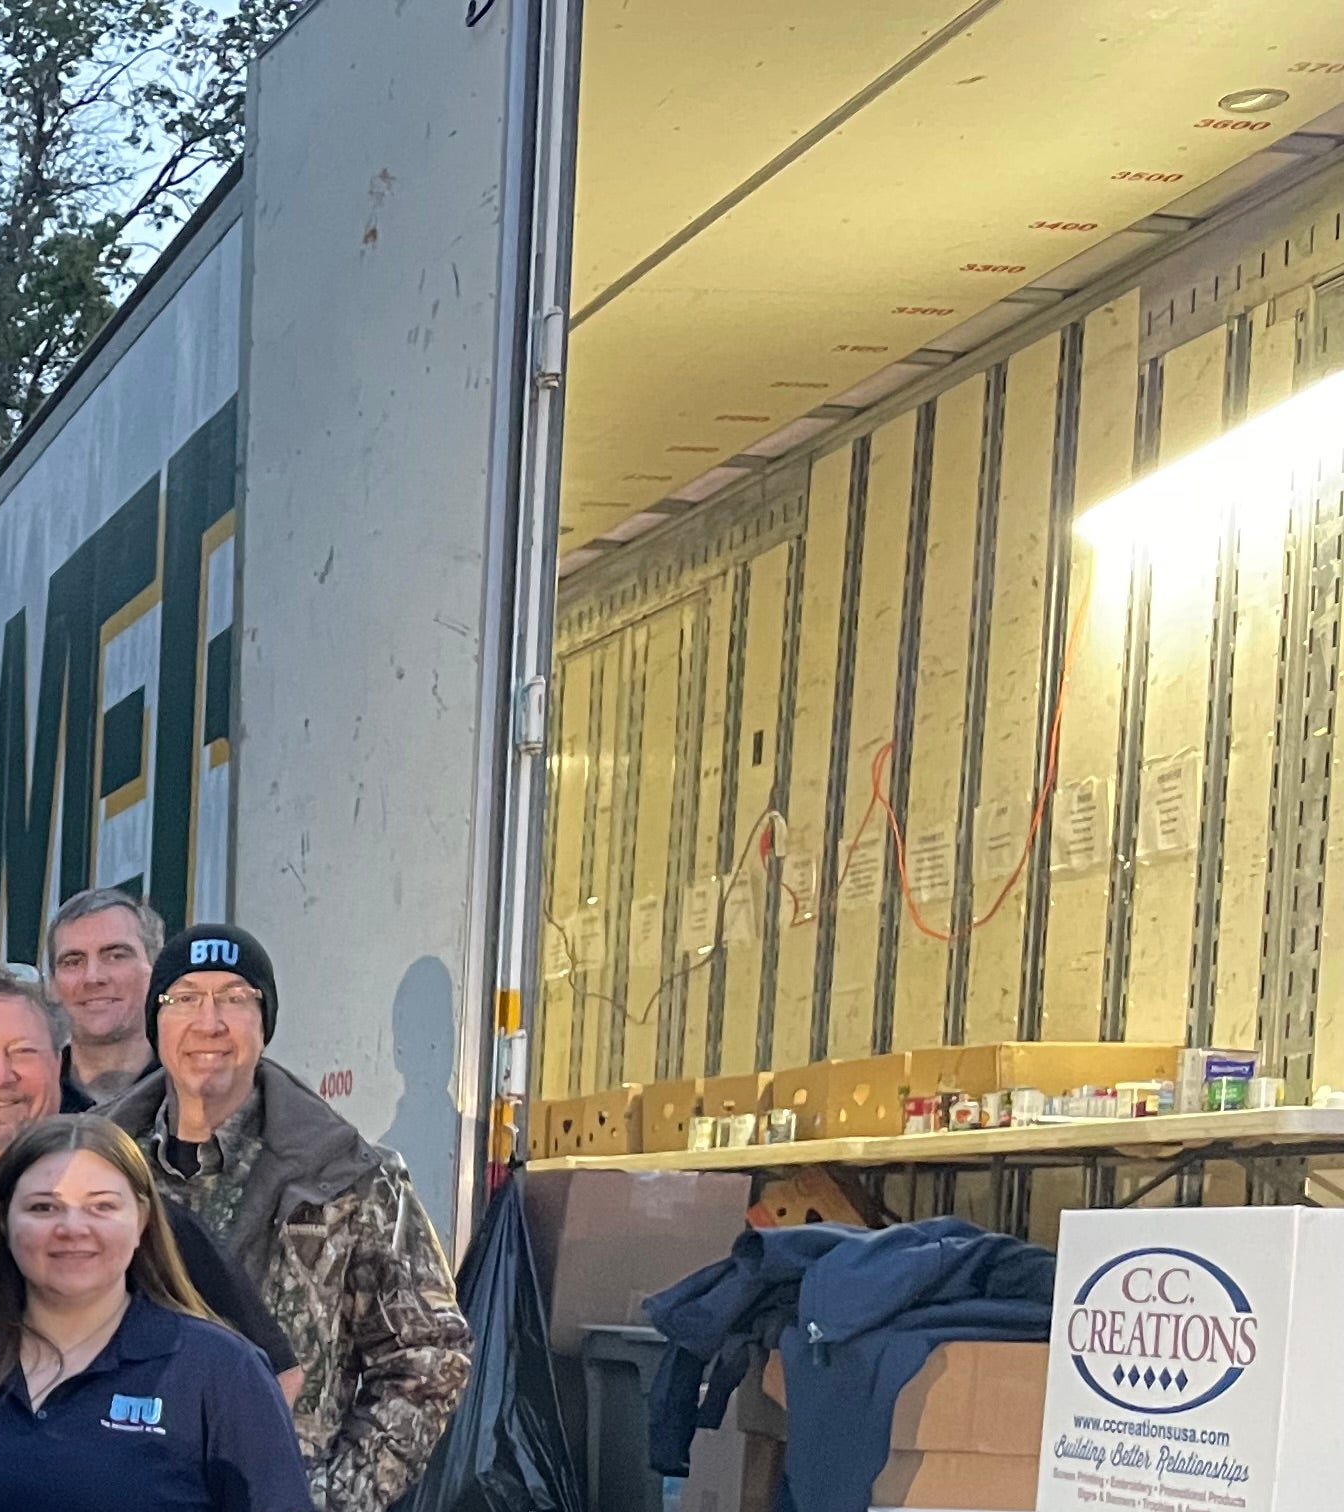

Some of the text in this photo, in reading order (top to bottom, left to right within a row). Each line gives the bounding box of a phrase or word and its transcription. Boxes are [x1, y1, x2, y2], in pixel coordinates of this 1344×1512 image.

[1193, 118, 1272, 132] 3600
[1111, 170, 1184, 183] 3500
[1028, 220, 1098, 232] 3400
[960, 262, 1026, 274] 3300
[190, 938, 240, 966] BTU
[319, 1069, 353, 1100] 4000
[1121, 1267, 1195, 1305] C.C.
[1067, 1307, 1258, 1366] CREATIONS
[1073, 1415, 1230, 1447] www.cccreationsusa.com
[1054, 1434, 1250, 1488] Building Better Relationships
